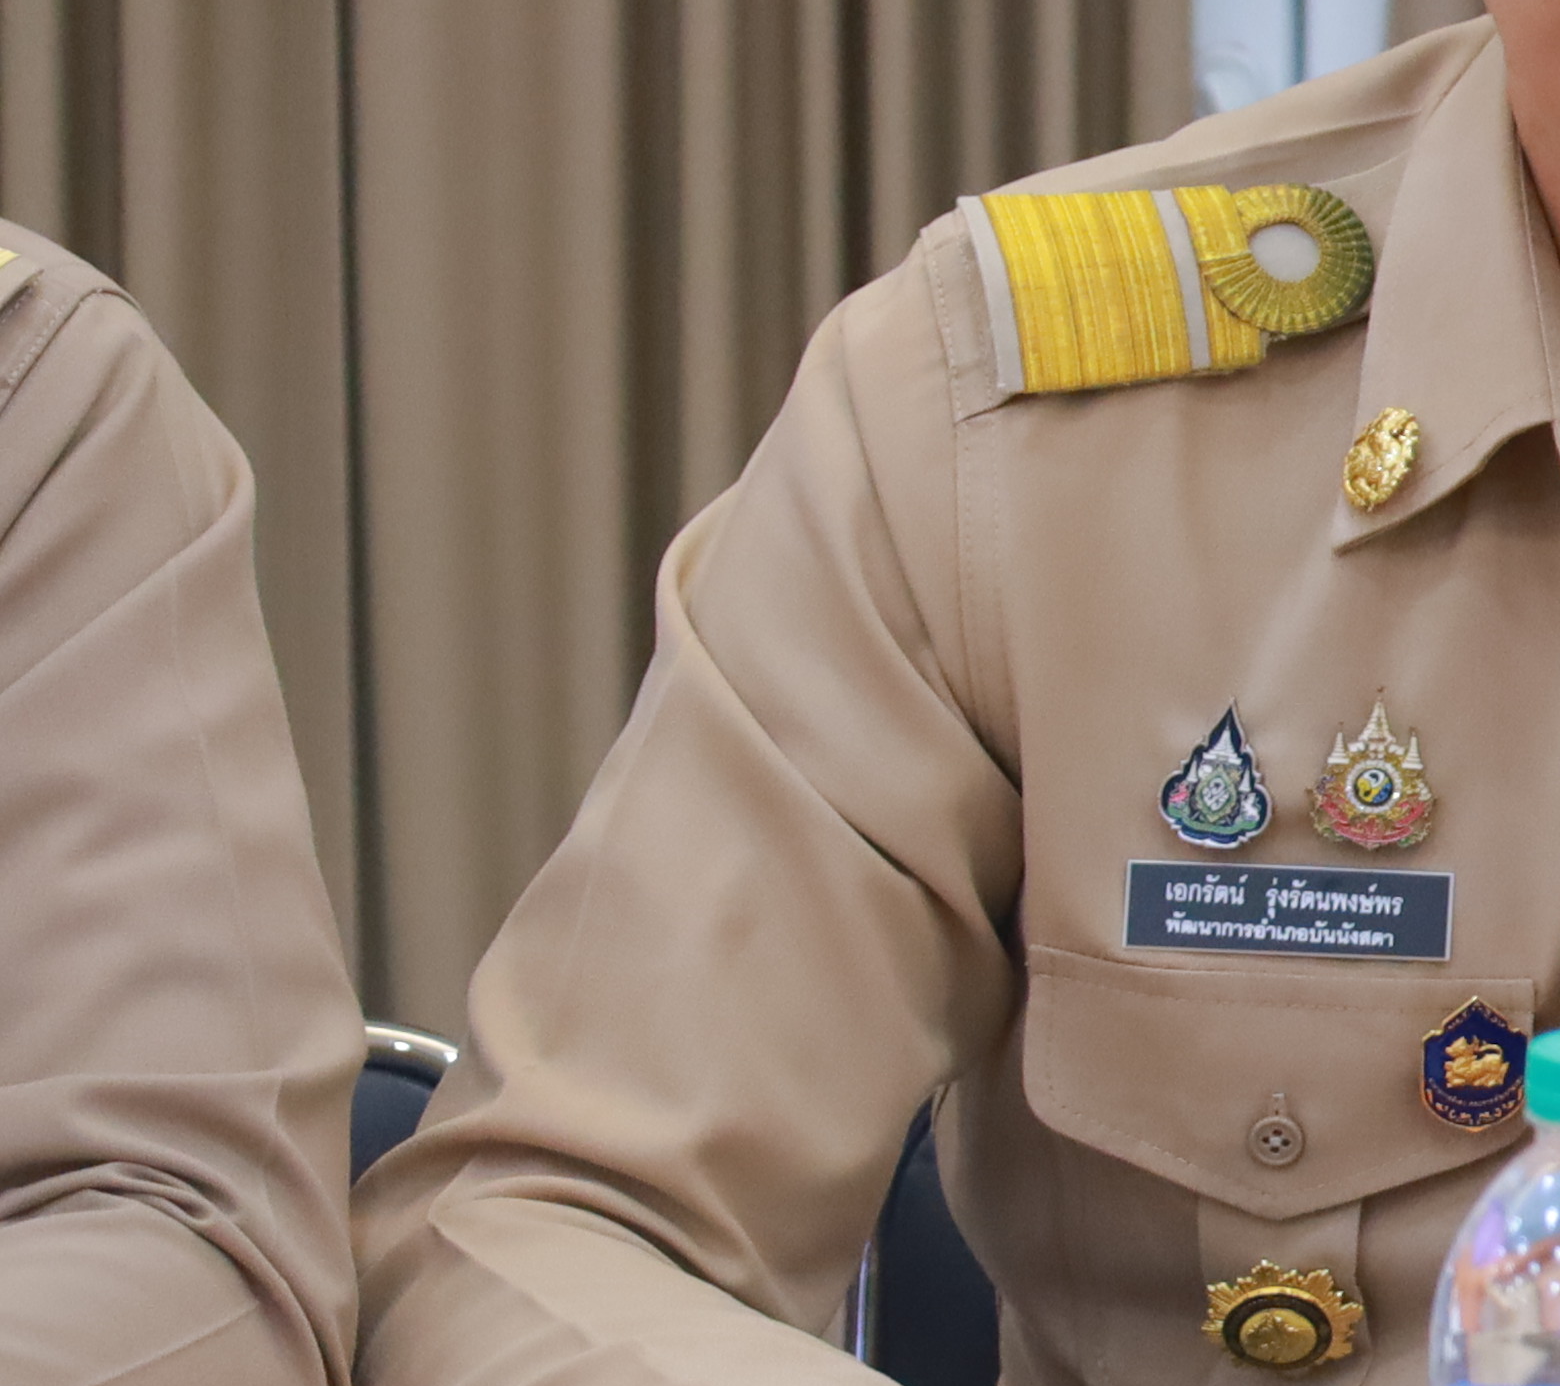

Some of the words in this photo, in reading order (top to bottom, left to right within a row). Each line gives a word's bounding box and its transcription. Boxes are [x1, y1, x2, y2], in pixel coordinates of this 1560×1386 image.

[1165, 874, 1248, 906] เอกรัตน์
[1266, 877, 1404, 919] รุ่งรัตนพงษ์พร
[1165, 911, 1395, 948] พัฒนาการอำเภอบันนังสตา
